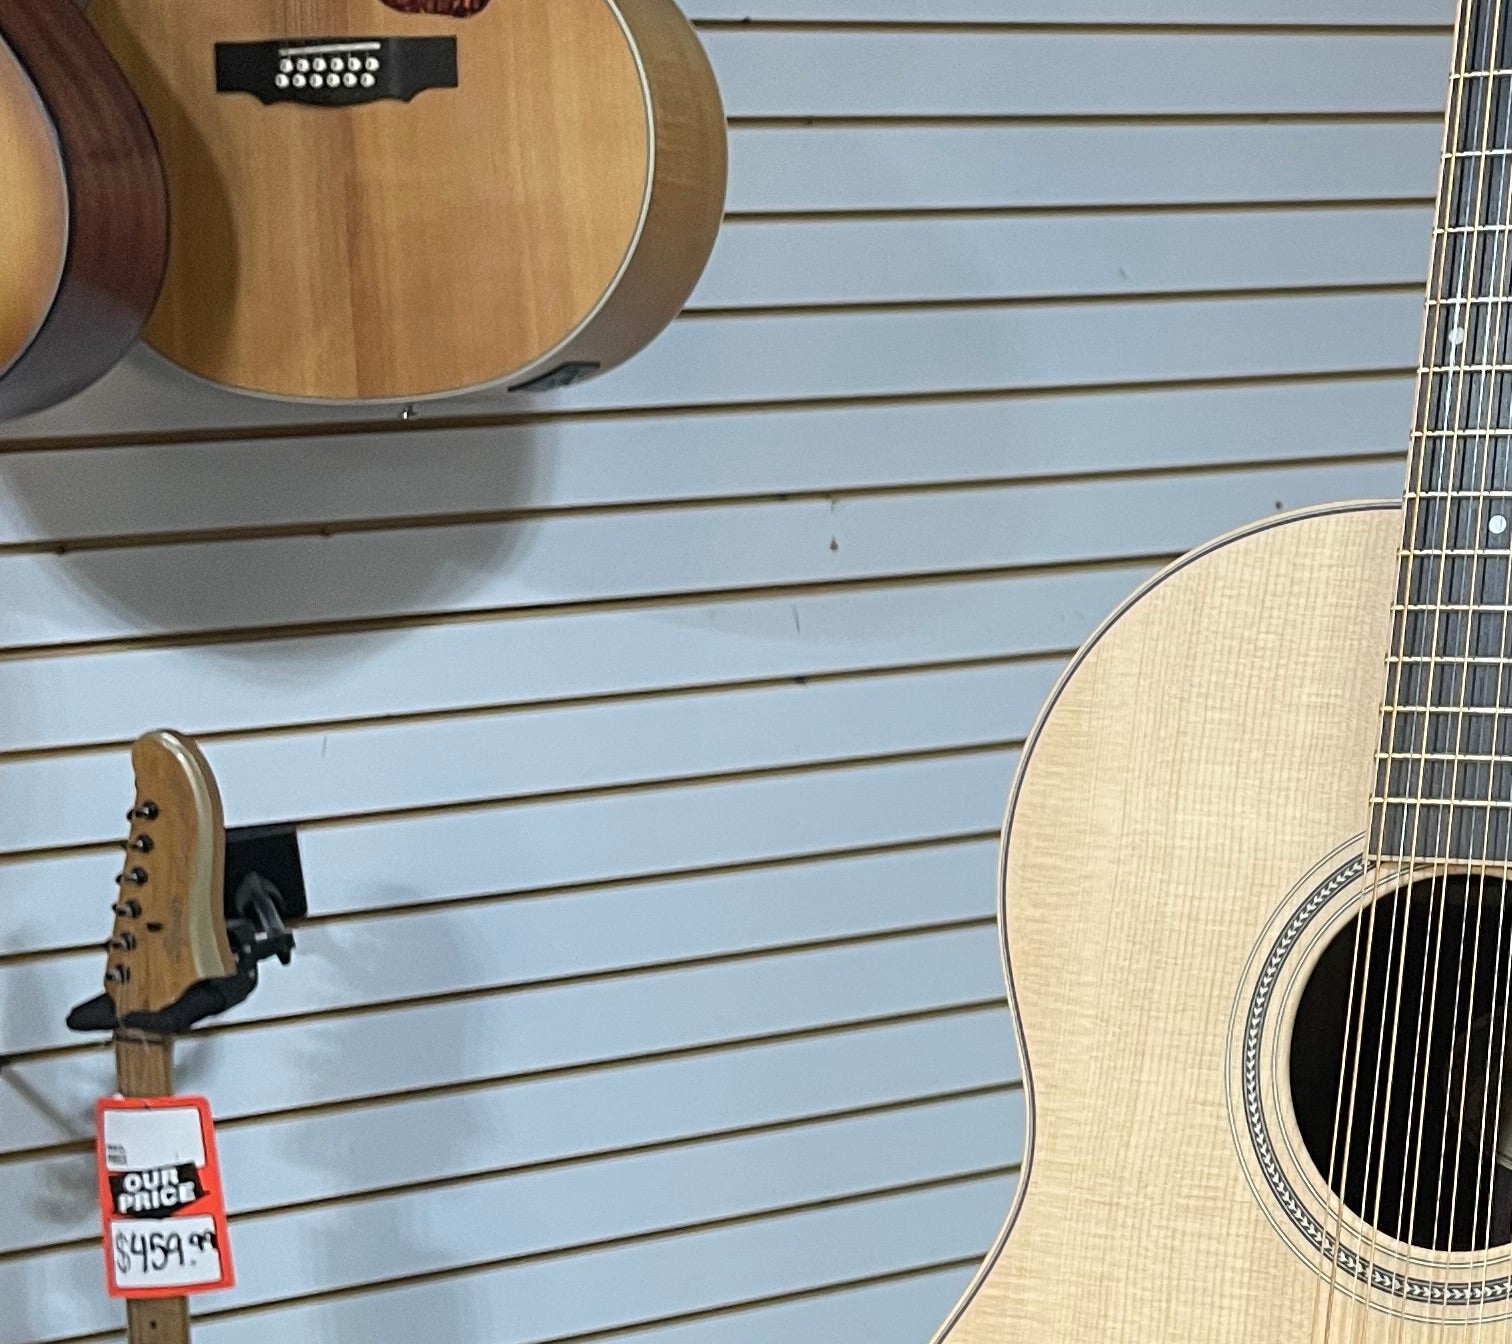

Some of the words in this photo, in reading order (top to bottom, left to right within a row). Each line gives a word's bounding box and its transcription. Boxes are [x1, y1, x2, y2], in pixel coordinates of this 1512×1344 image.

[123, 1166, 179, 1193] OUR
[117, 1181, 196, 1214] PRICE
[115, 1227, 218, 1276] $459.99
